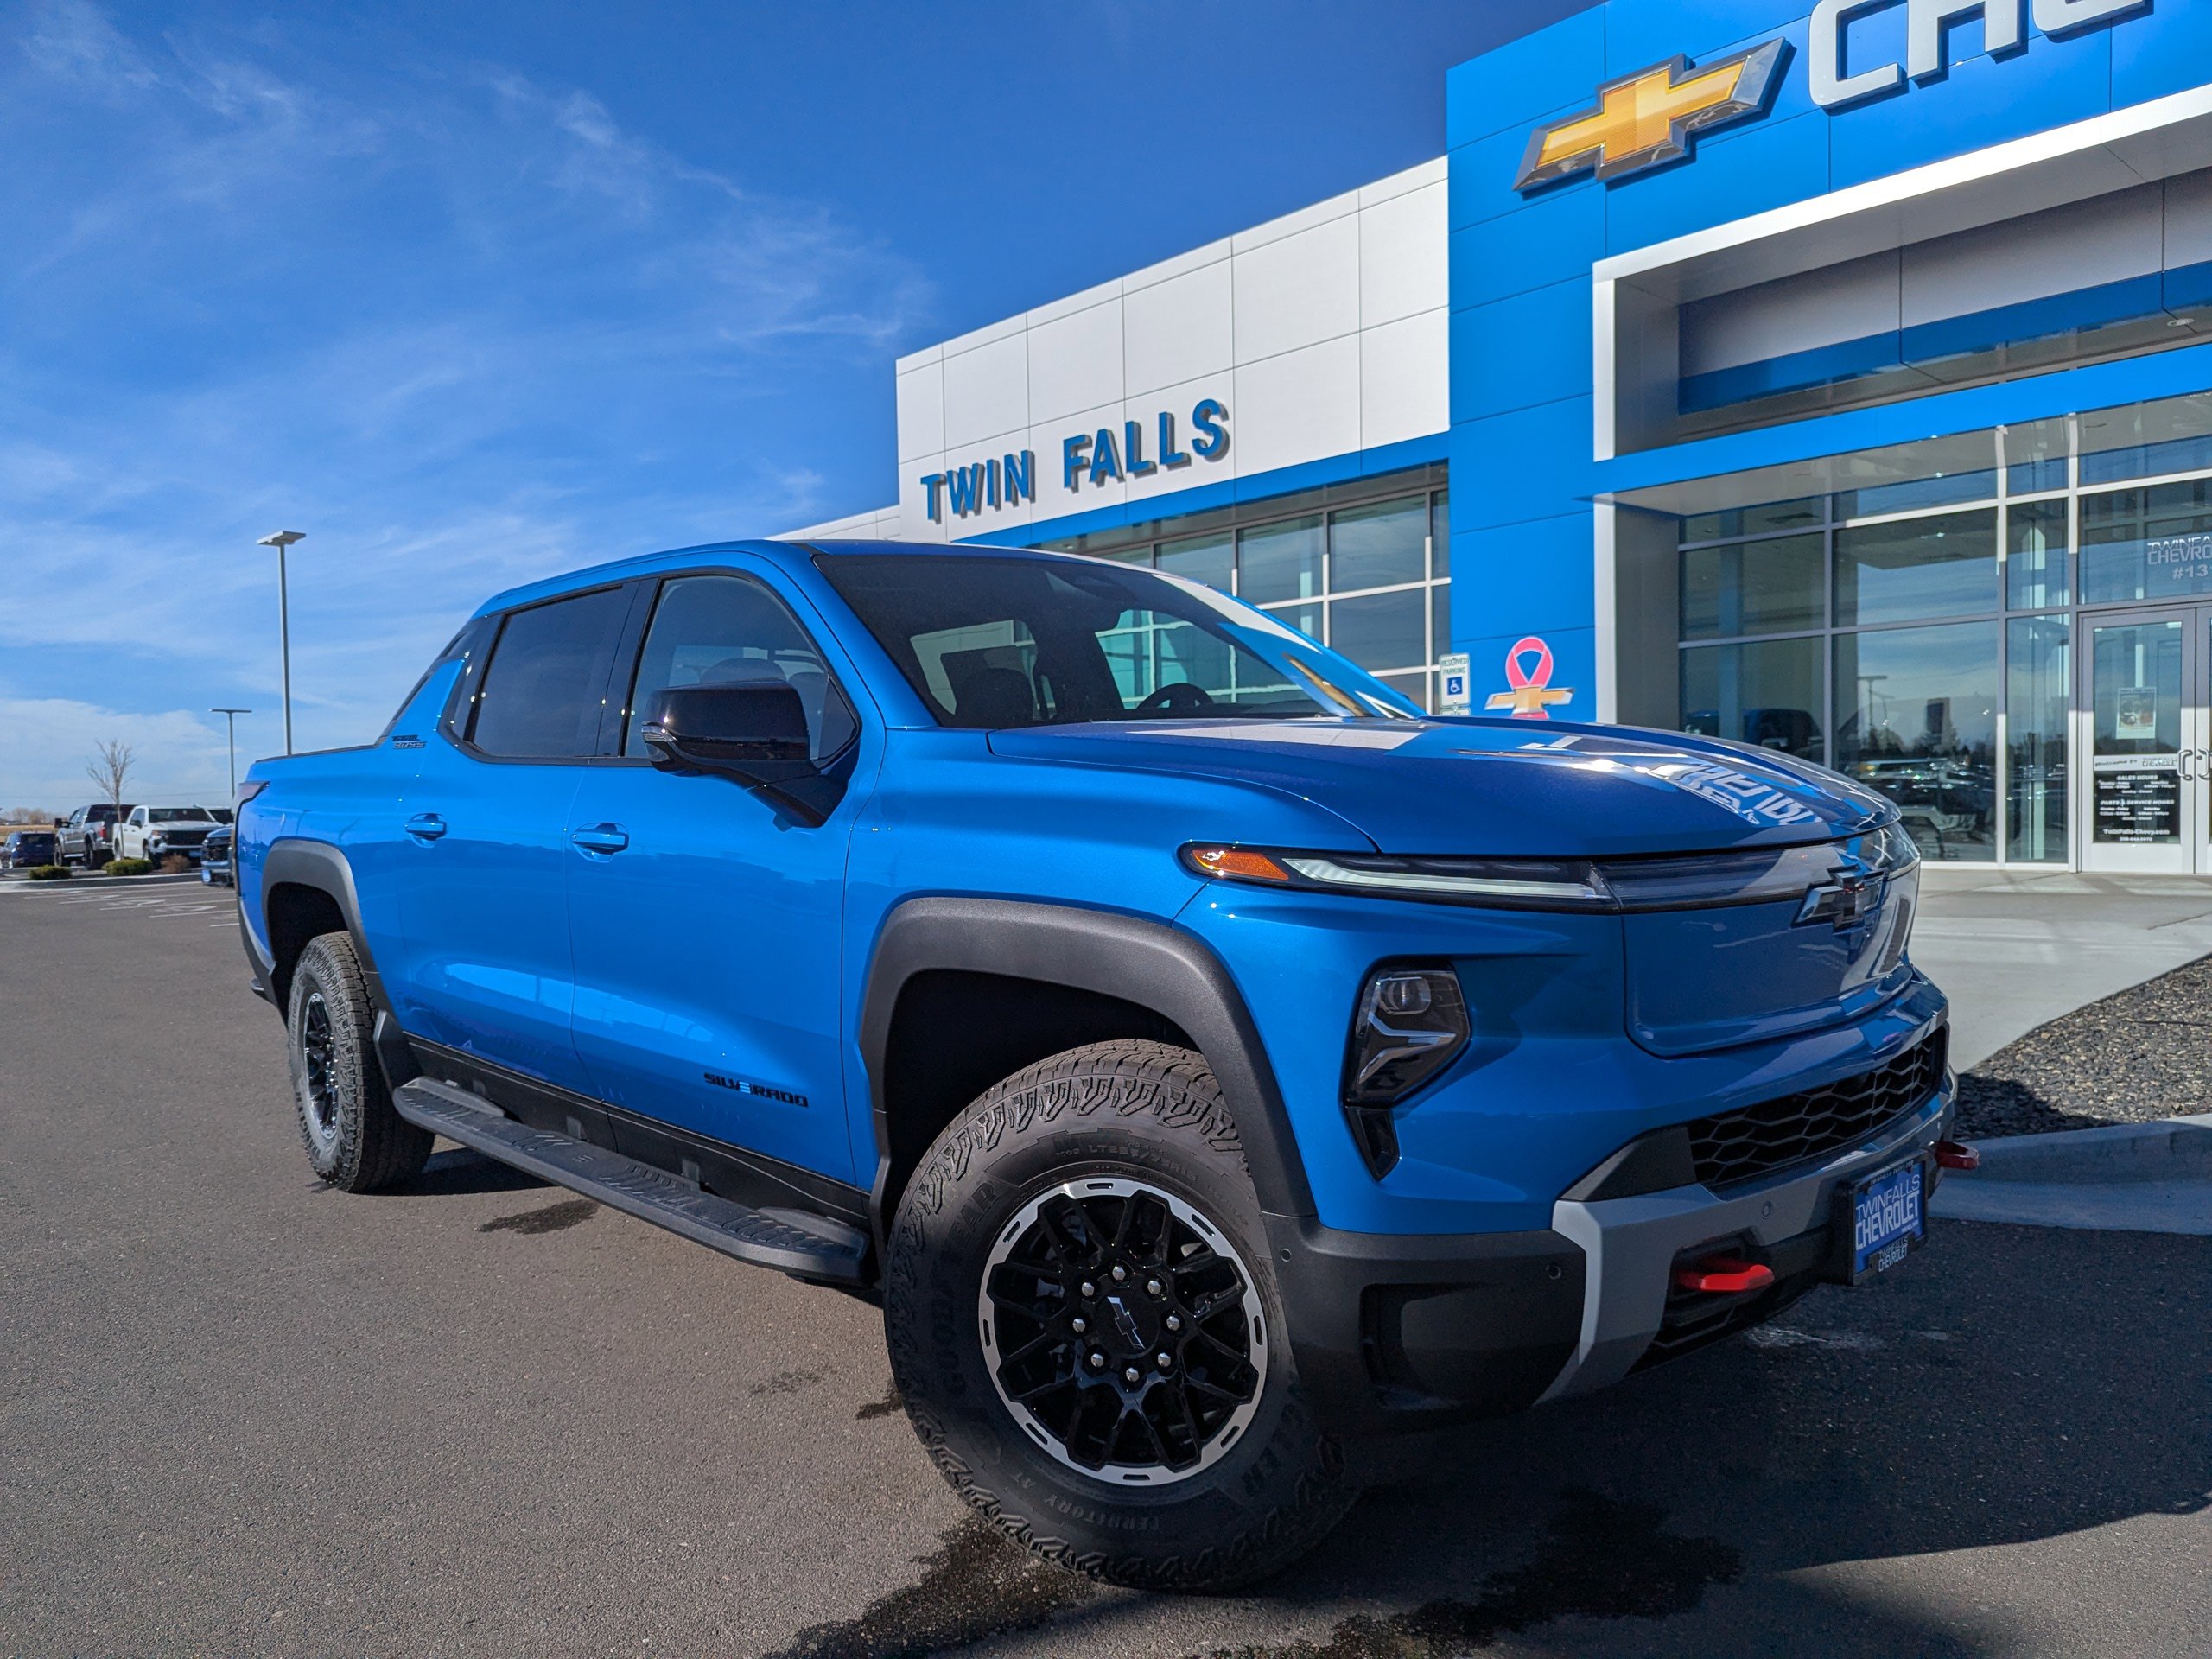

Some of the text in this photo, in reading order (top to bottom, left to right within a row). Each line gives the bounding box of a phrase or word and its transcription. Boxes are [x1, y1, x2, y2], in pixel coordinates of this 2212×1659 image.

[1808, 0, 2146, 106] CH
[920, 398, 1230, 524] TWIN FALLS
[2172, 564, 2212, 580] #13
[703, 1071, 810, 1108] SILVERADO
[1856, 1190, 1920, 1251] CHEVROLET
[1878, 1244, 1908, 1272] CHEVROLET
